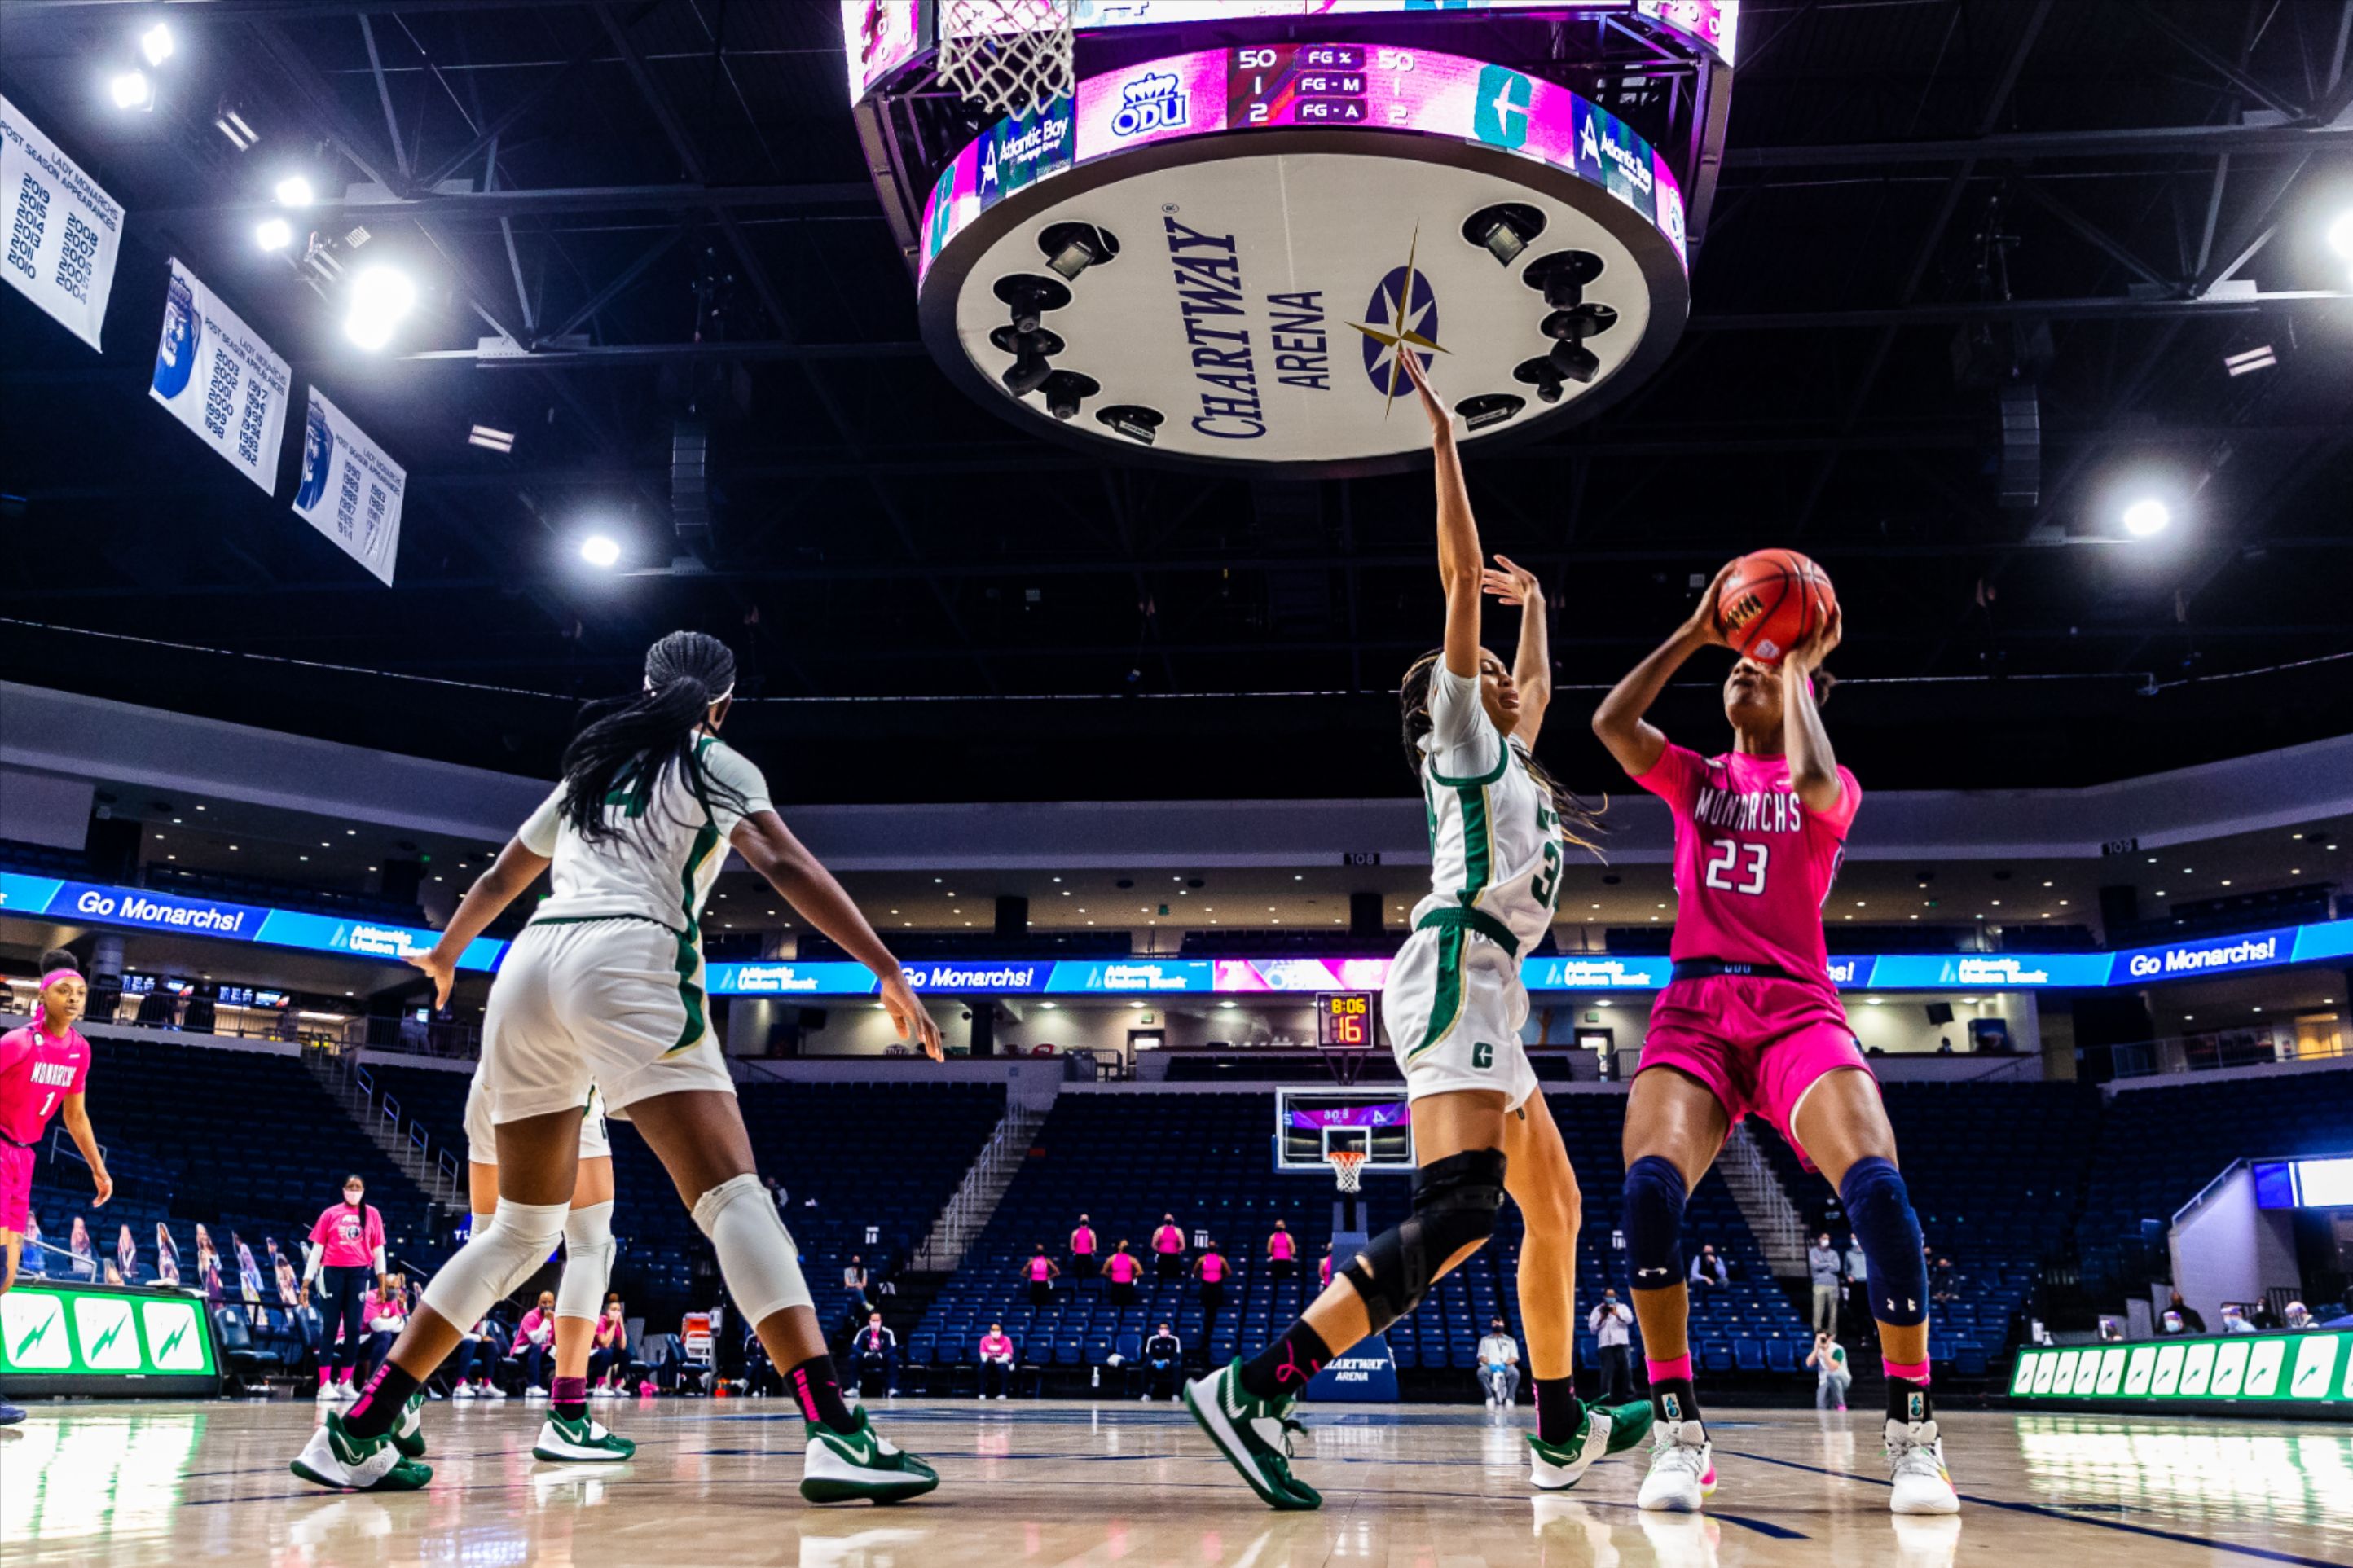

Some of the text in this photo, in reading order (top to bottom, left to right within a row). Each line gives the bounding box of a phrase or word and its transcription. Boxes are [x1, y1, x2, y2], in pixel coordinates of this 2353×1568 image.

[1239, 48, 1277, 68] 50
[1308, 51, 1333, 64] FG
[1378, 49, 1414, 71] 50
[1255, 76, 1262, 94] 1
[1301, 78, 1326, 90] FG
[1344, 78, 1359, 91] M
[1111, 94, 1186, 137] ODU
[1250, 103, 1268, 121] 2
[1302, 104, 1327, 117] FG
[1345, 104, 1359, 118] A
[1389, 106, 1408, 125] 2
[998, 116, 1068, 165] Atlantic Bay
[1, 120, 116, 232] POST SEASON APPEARANCES
[24, 173, 50, 204] 2019
[52, 152, 118, 220] LADY MONARCHS
[17, 203, 44, 235] 2014
[20, 188, 46, 219] 2015
[14, 218, 41, 248] 2013
[64, 227, 95, 258] 2007
[67, 212, 99, 246] 2008
[11, 233, 34, 261] 2011
[62, 242, 92, 275] 2006
[7, 248, 36, 279] 2010
[56, 271, 87, 305] 2004
[205, 318, 222, 337] POST
[222, 332, 245, 359] SEASON
[1266, 291, 1330, 391] ARENA
[213, 362, 238, 389] 2002
[216, 349, 240, 375] 2003
[208, 389, 234, 416] 2000
[211, 376, 232, 399] 2001
[206, 404, 227, 425] 1999
[239, 443, 257, 467] 1992
[1694, 787, 1801, 832] MONARCHS
[1706, 839, 1768, 894] 23
[77, 890, 244, 932] Go Monarchs!
[2130, 937, 2276, 976] Go Monarchs!
[930, 967, 1034, 986] Monarchs!
[1331, 999, 1366, 1013] 8:06
[1339, 1015, 1362, 1042] 16
[30, 1061, 77, 1087] MONARCHS
[39, 1092, 55, 1115] 1
[1335, 1372, 1369, 1381] ARENA
